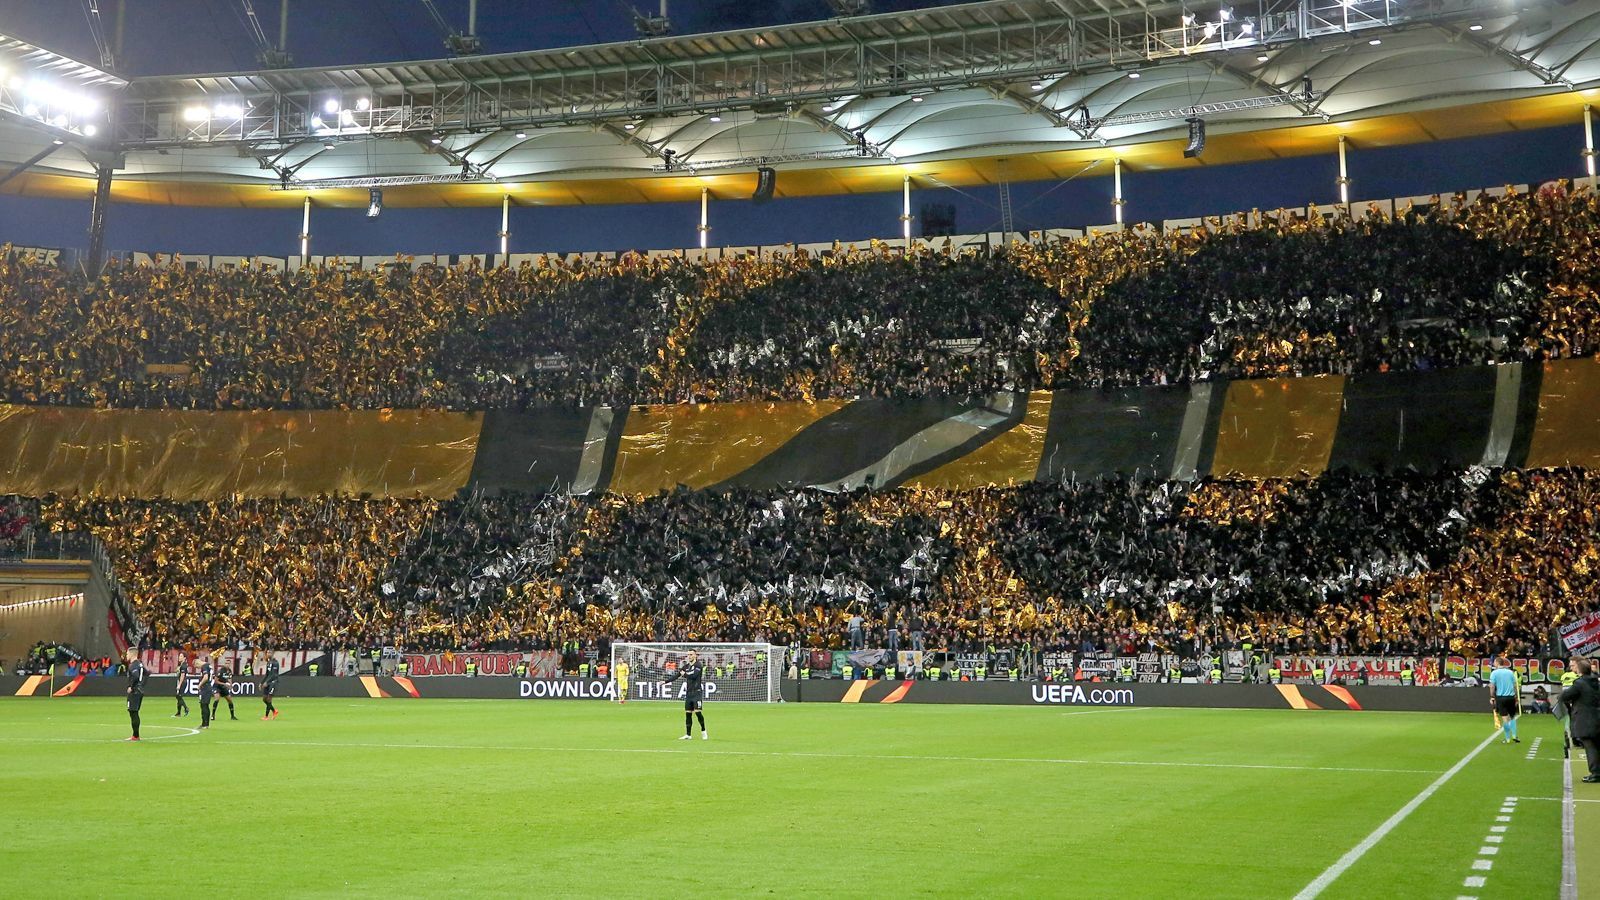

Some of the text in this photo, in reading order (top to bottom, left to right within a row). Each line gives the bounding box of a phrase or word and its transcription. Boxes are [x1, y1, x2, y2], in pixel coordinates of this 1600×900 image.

[1280, 657, 1417, 672] EINTRACHT
[520, 680, 717, 698] DOWNLOA THE AP
[1031, 684, 1134, 703] UEFA.com
